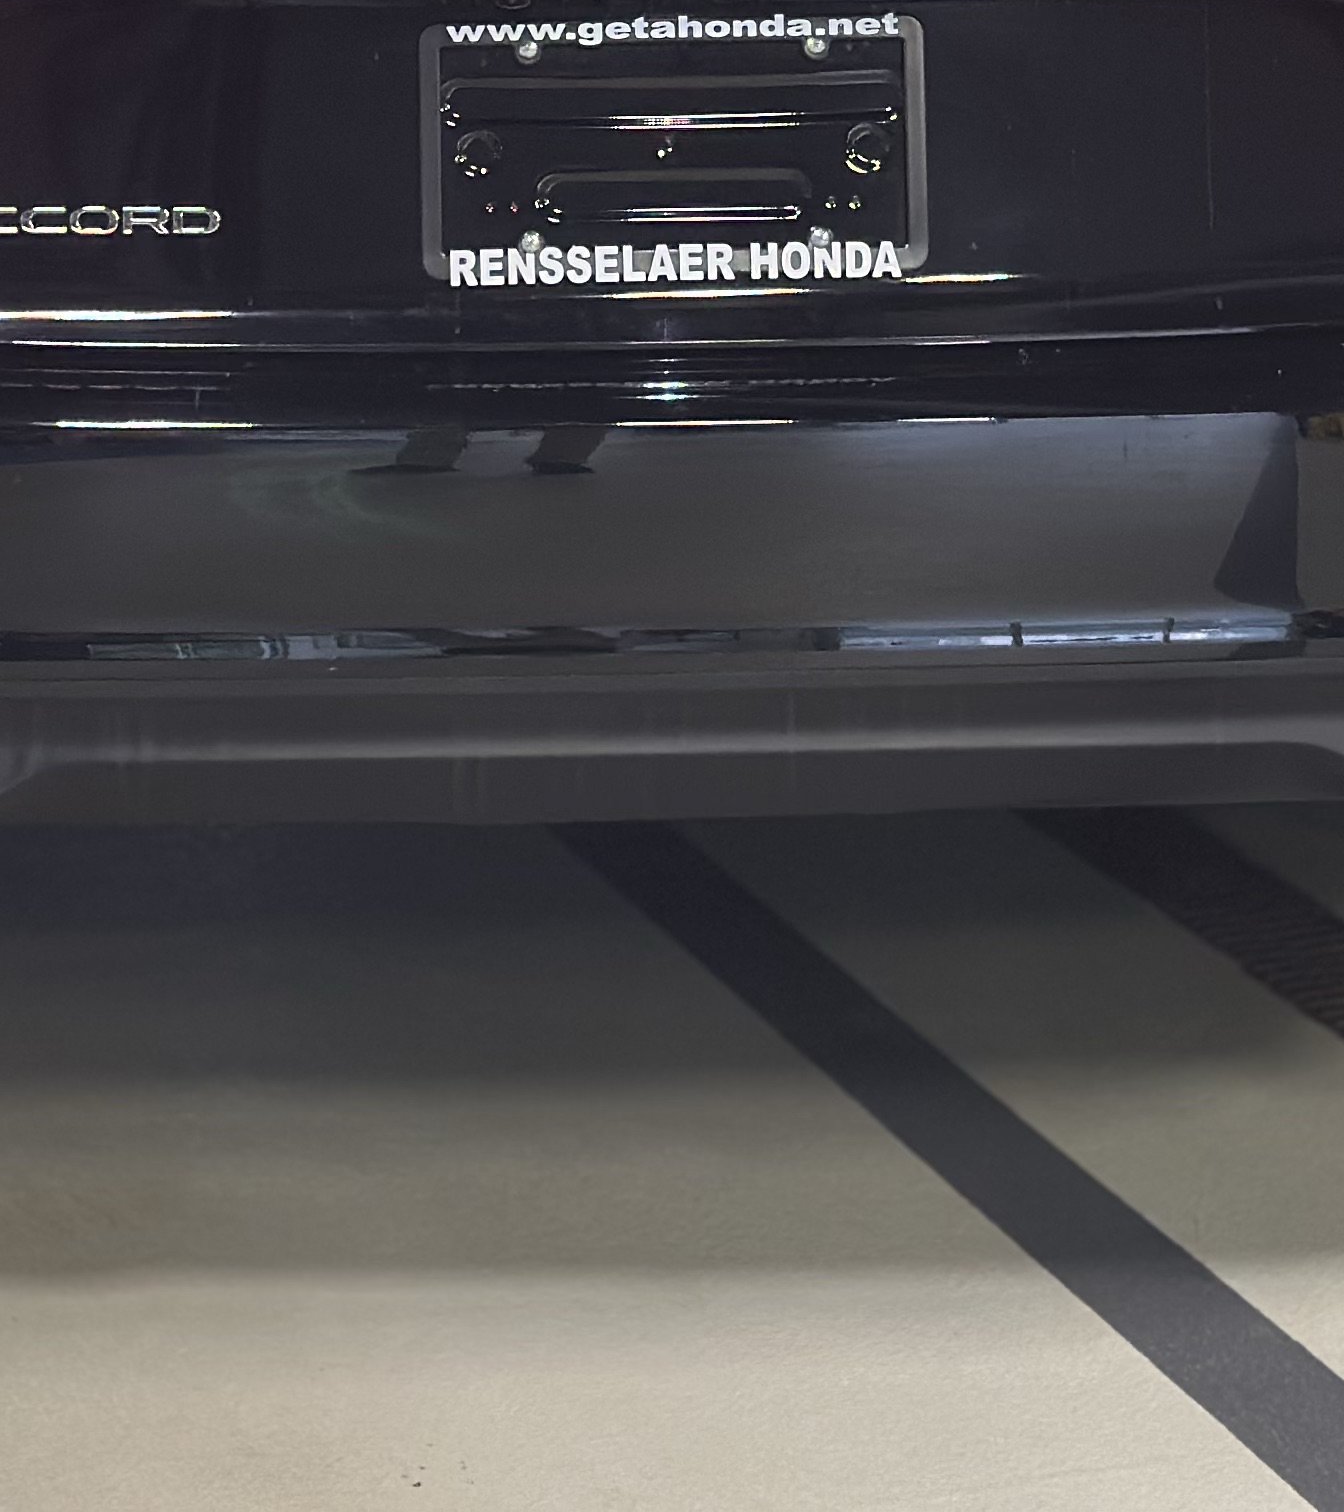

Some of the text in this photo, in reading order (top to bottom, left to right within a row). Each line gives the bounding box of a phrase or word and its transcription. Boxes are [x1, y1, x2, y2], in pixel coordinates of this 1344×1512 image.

[446, 13, 900, 45] www.getahonda.net
[449, 240, 902, 287] RENSSELAER HONDA
